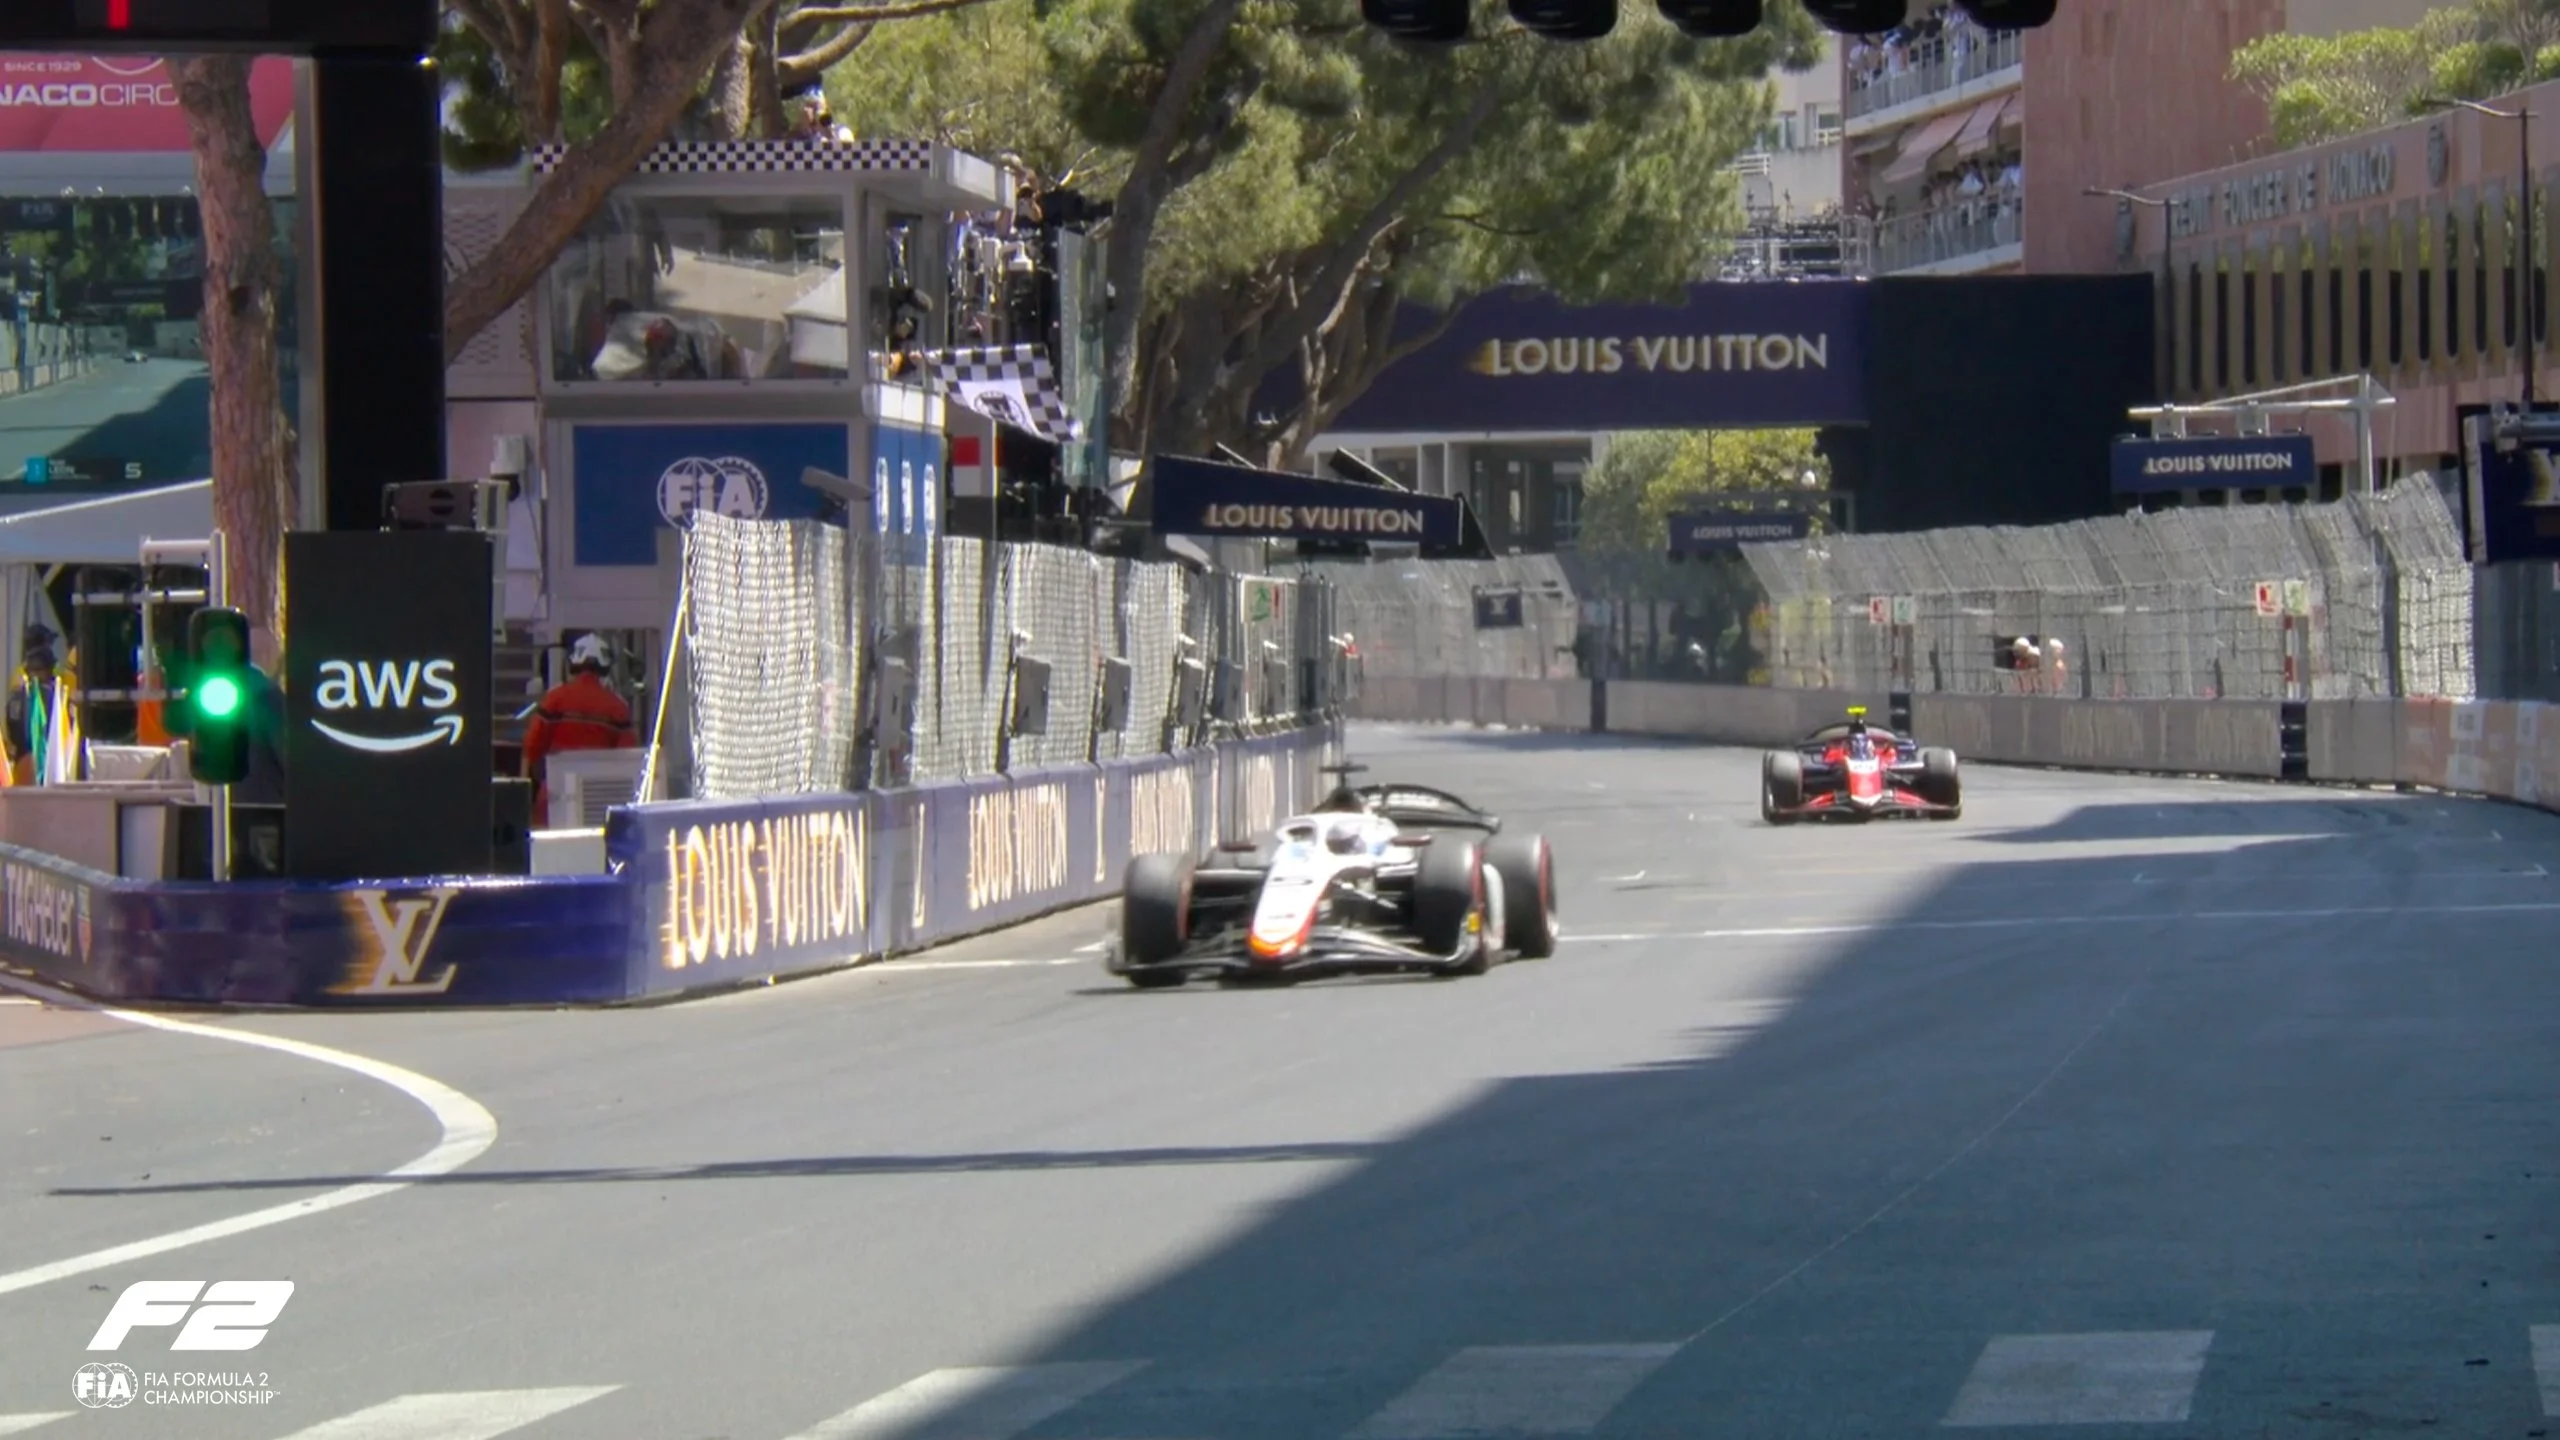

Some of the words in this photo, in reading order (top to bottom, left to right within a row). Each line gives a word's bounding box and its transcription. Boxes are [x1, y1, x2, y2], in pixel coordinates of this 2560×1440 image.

[4, 61, 46, 72] SINCE
[49, 60, 82, 72] 1929
[1491, 336, 1623, 377] LOUIS
[1635, 332, 1828, 373] VUITTON
[2145, 455, 2205, 474] LOUIS
[2209, 452, 2293, 471] VUITTON
[1206, 503, 1293, 529] LOUIS
[1302, 506, 1424, 533] VUITTON
[1693, 525, 1734, 539] LOUIS
[1736, 524, 1793, 538] VUITTON
[316, 659, 458, 710] aws
[968, 790, 1013, 911] LOUIS
[1014, 781, 1069, 895] VUITTON
[666, 820, 759, 968] LOUIS
[763, 808, 865, 949] VUITTON
